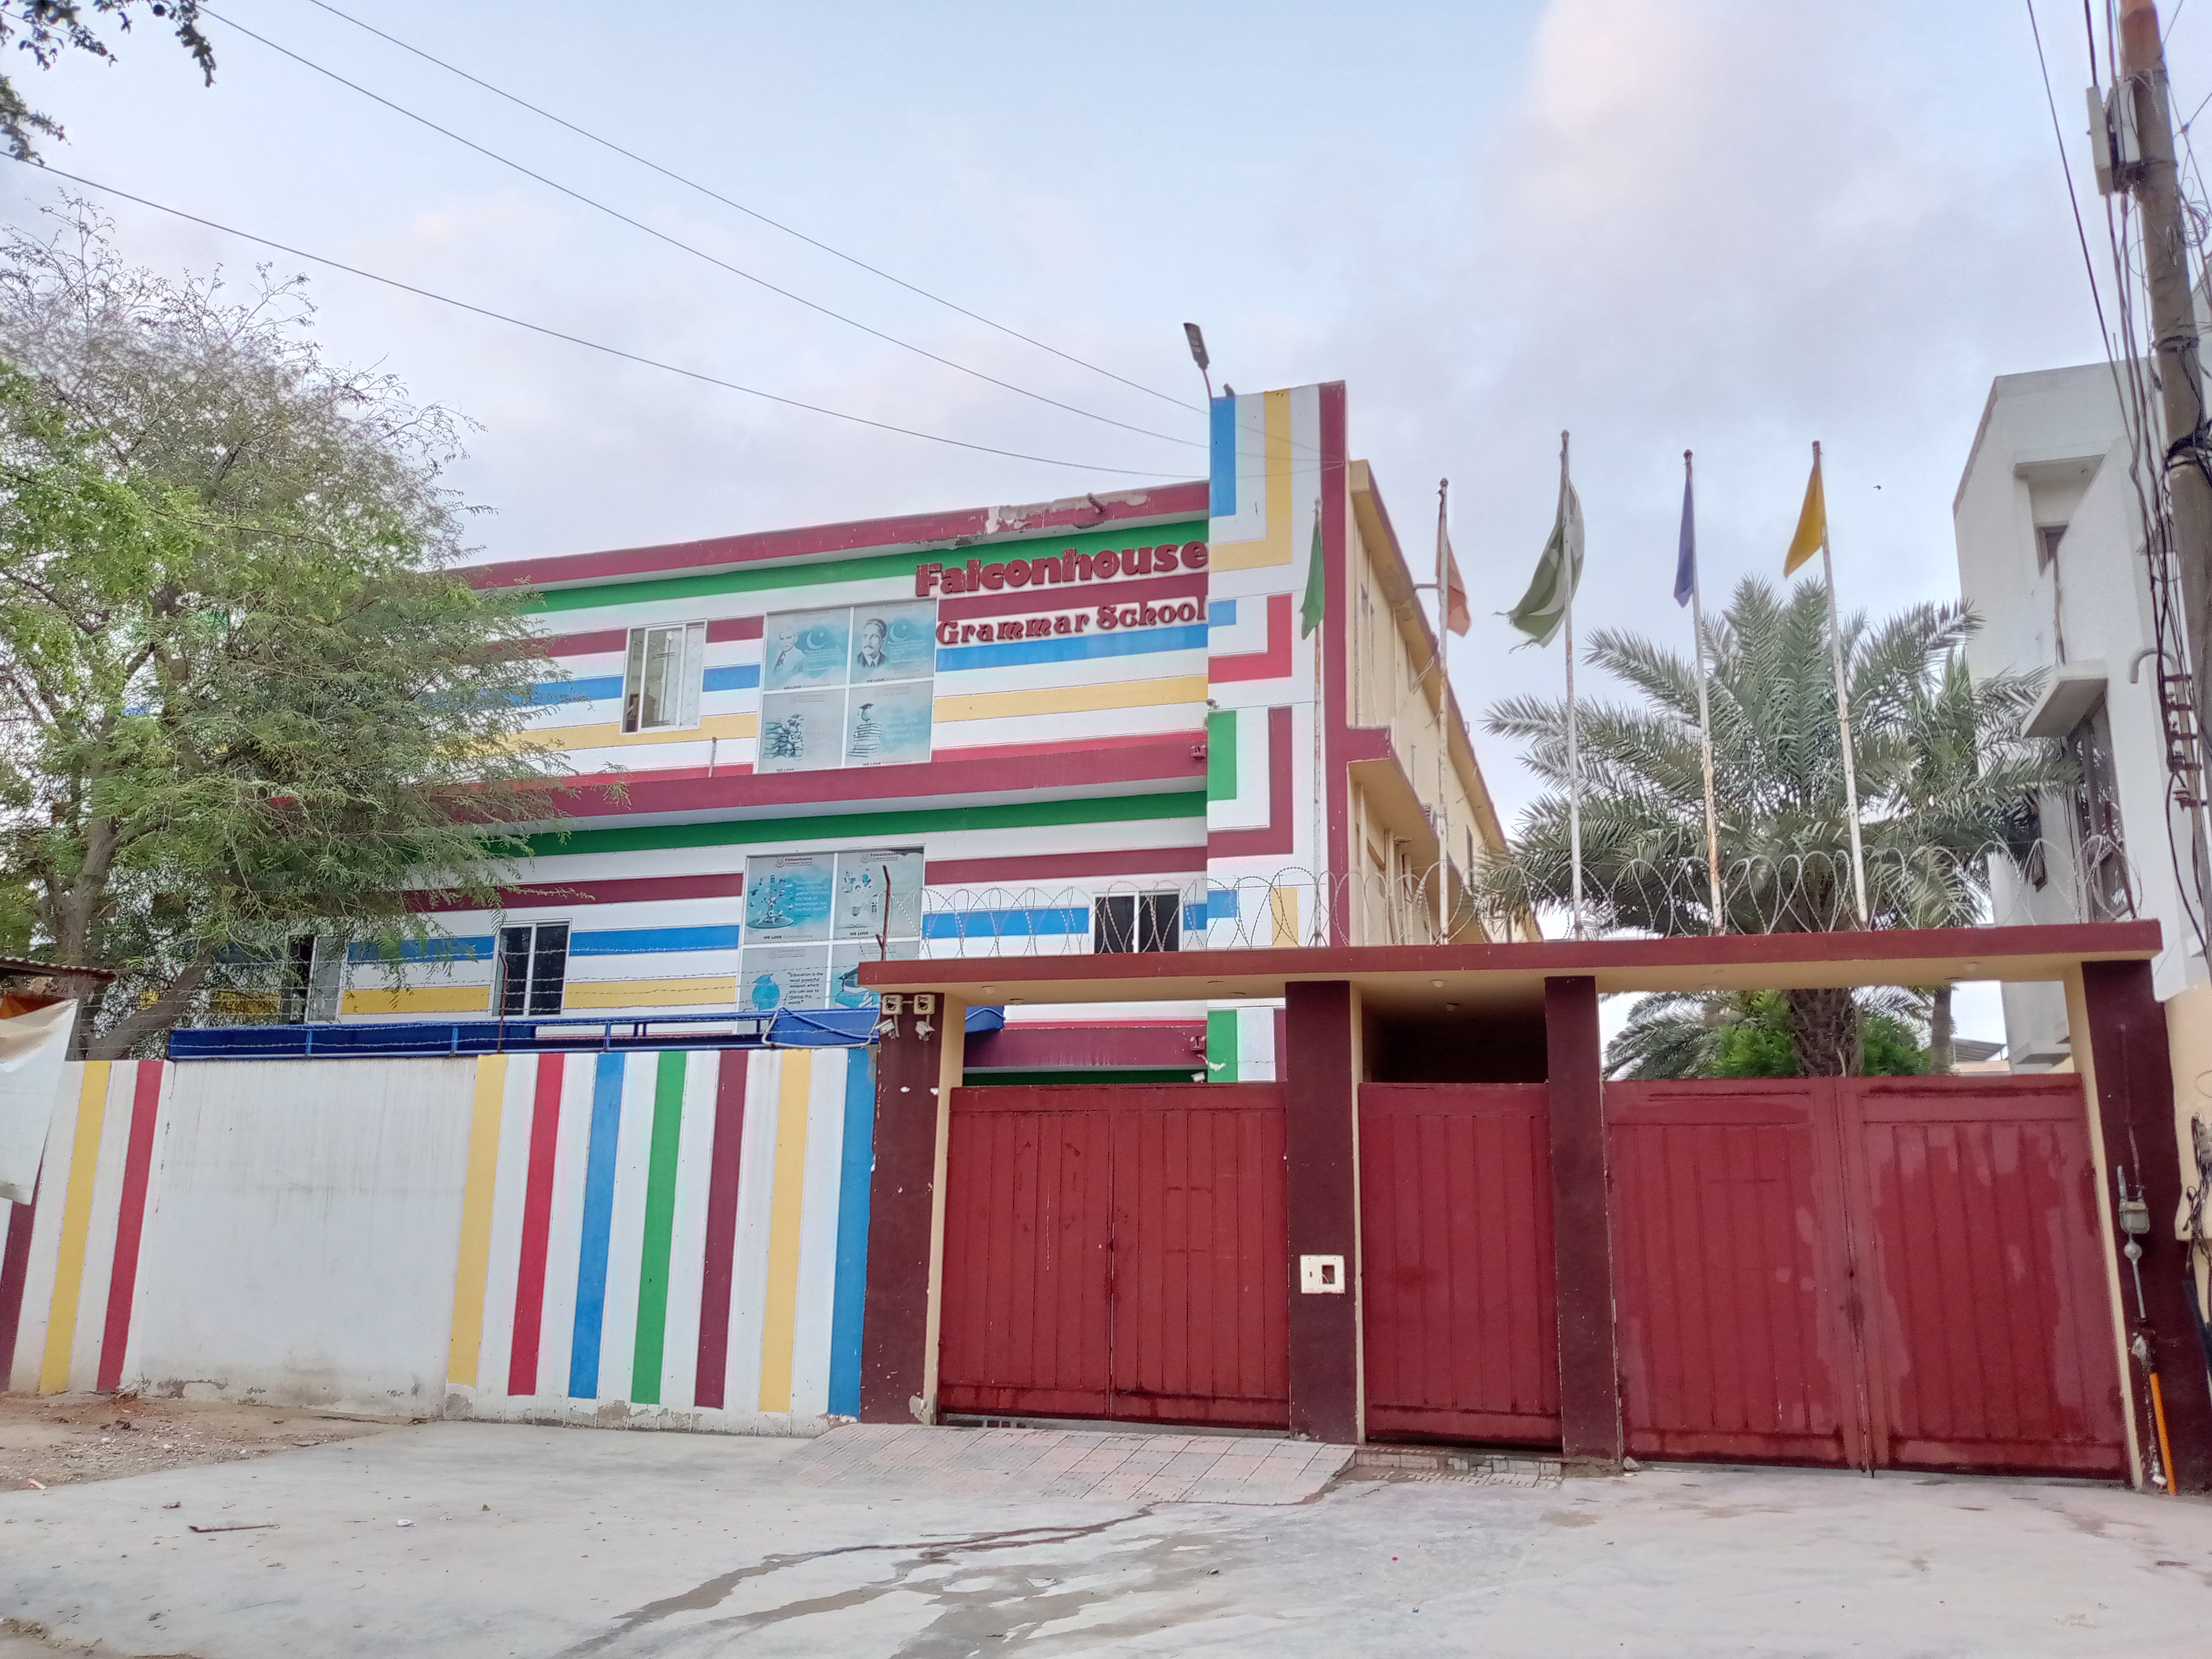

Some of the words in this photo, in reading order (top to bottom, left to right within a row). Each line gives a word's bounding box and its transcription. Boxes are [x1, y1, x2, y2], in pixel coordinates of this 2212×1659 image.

[915, 540, 1208, 597] Falconhouse
[936, 613, 1089, 645] Grammar
[1097, 594, 1207, 630] School
